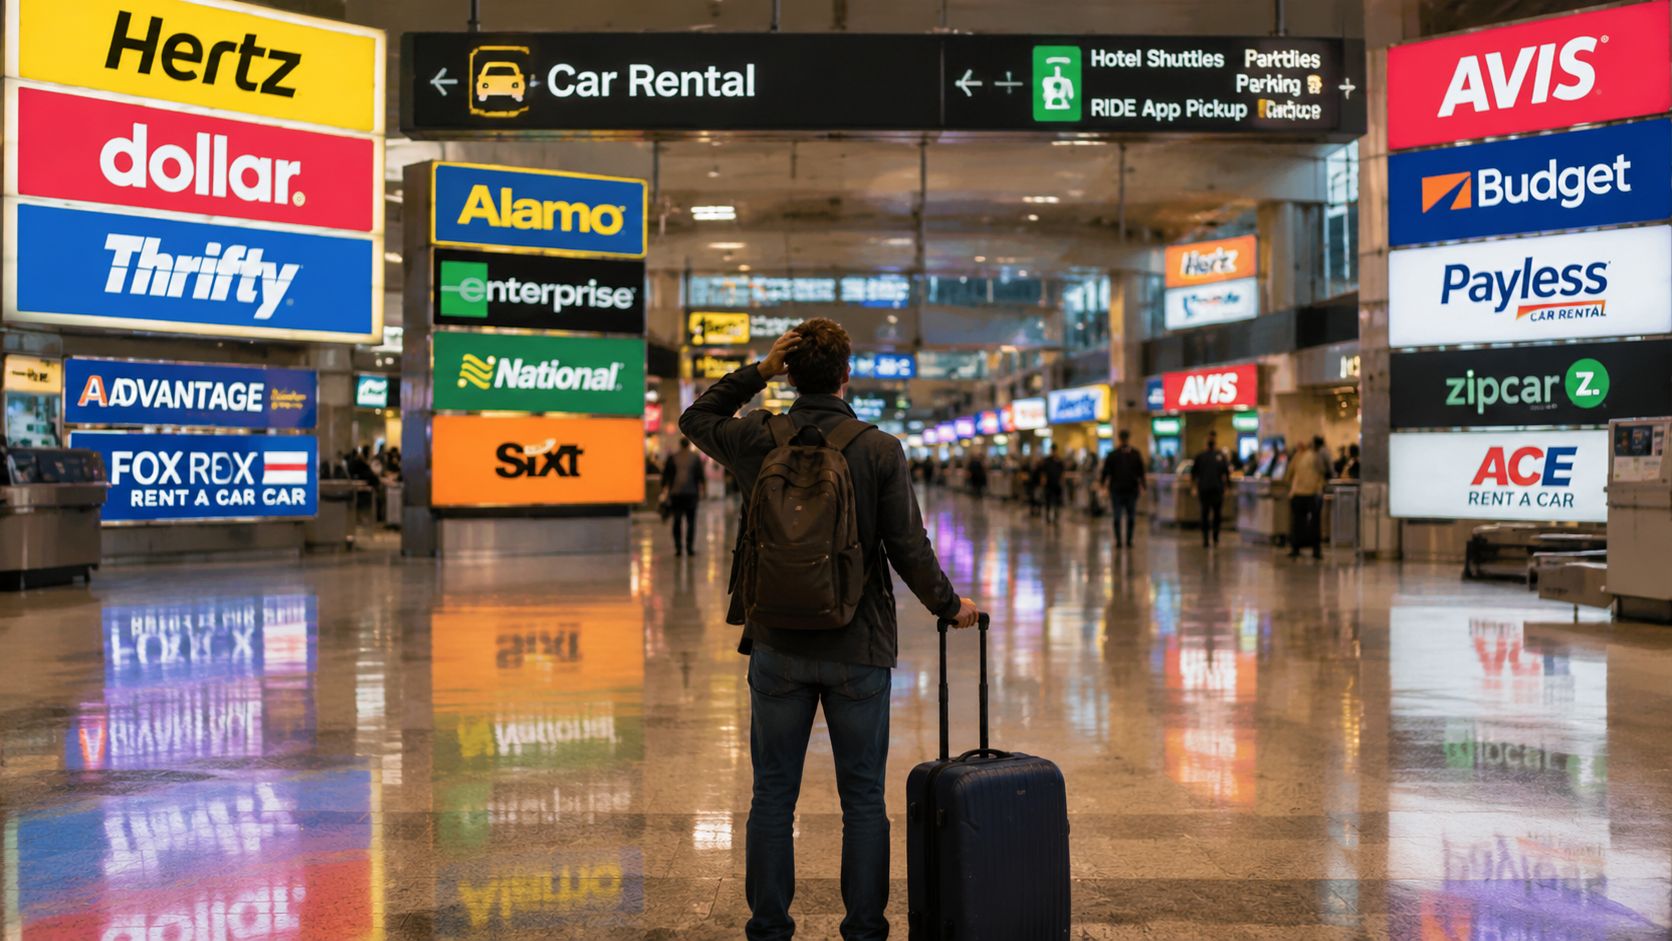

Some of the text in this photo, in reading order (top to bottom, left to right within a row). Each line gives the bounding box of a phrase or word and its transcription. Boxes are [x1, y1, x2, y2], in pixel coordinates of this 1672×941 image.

[105, 11, 301, 98] Hertz
[1091, 49, 1225, 67] Hotel Shuttles
[548, 64, 756, 97] Car Rental
[1437, 36, 1598, 117] AVIS
[1091, 98, 1136, 117] RIDE
[1142, 99, 1181, 121] App
[1186, 98, 1248, 121] Pickup
[1478, 154, 1631, 208] Budget
[457, 185, 625, 235] Alamo
[104, 234, 300, 319] Thrifty
[1441, 257, 1608, 312] Payless
[459, 278, 635, 313] enterprise
[1530, 305, 1606, 322] CAR RENTAL
[494, 357, 619, 391] National
[1179, 373, 1238, 405] AVIS
[1446, 369, 1560, 415] zipcar
[111, 451, 183, 485] FOX
[1471, 446, 1578, 486] ACE
[131, 488, 306, 507] RENT A CAR CAR
[1469, 491, 1575, 508] RENT A CAR
